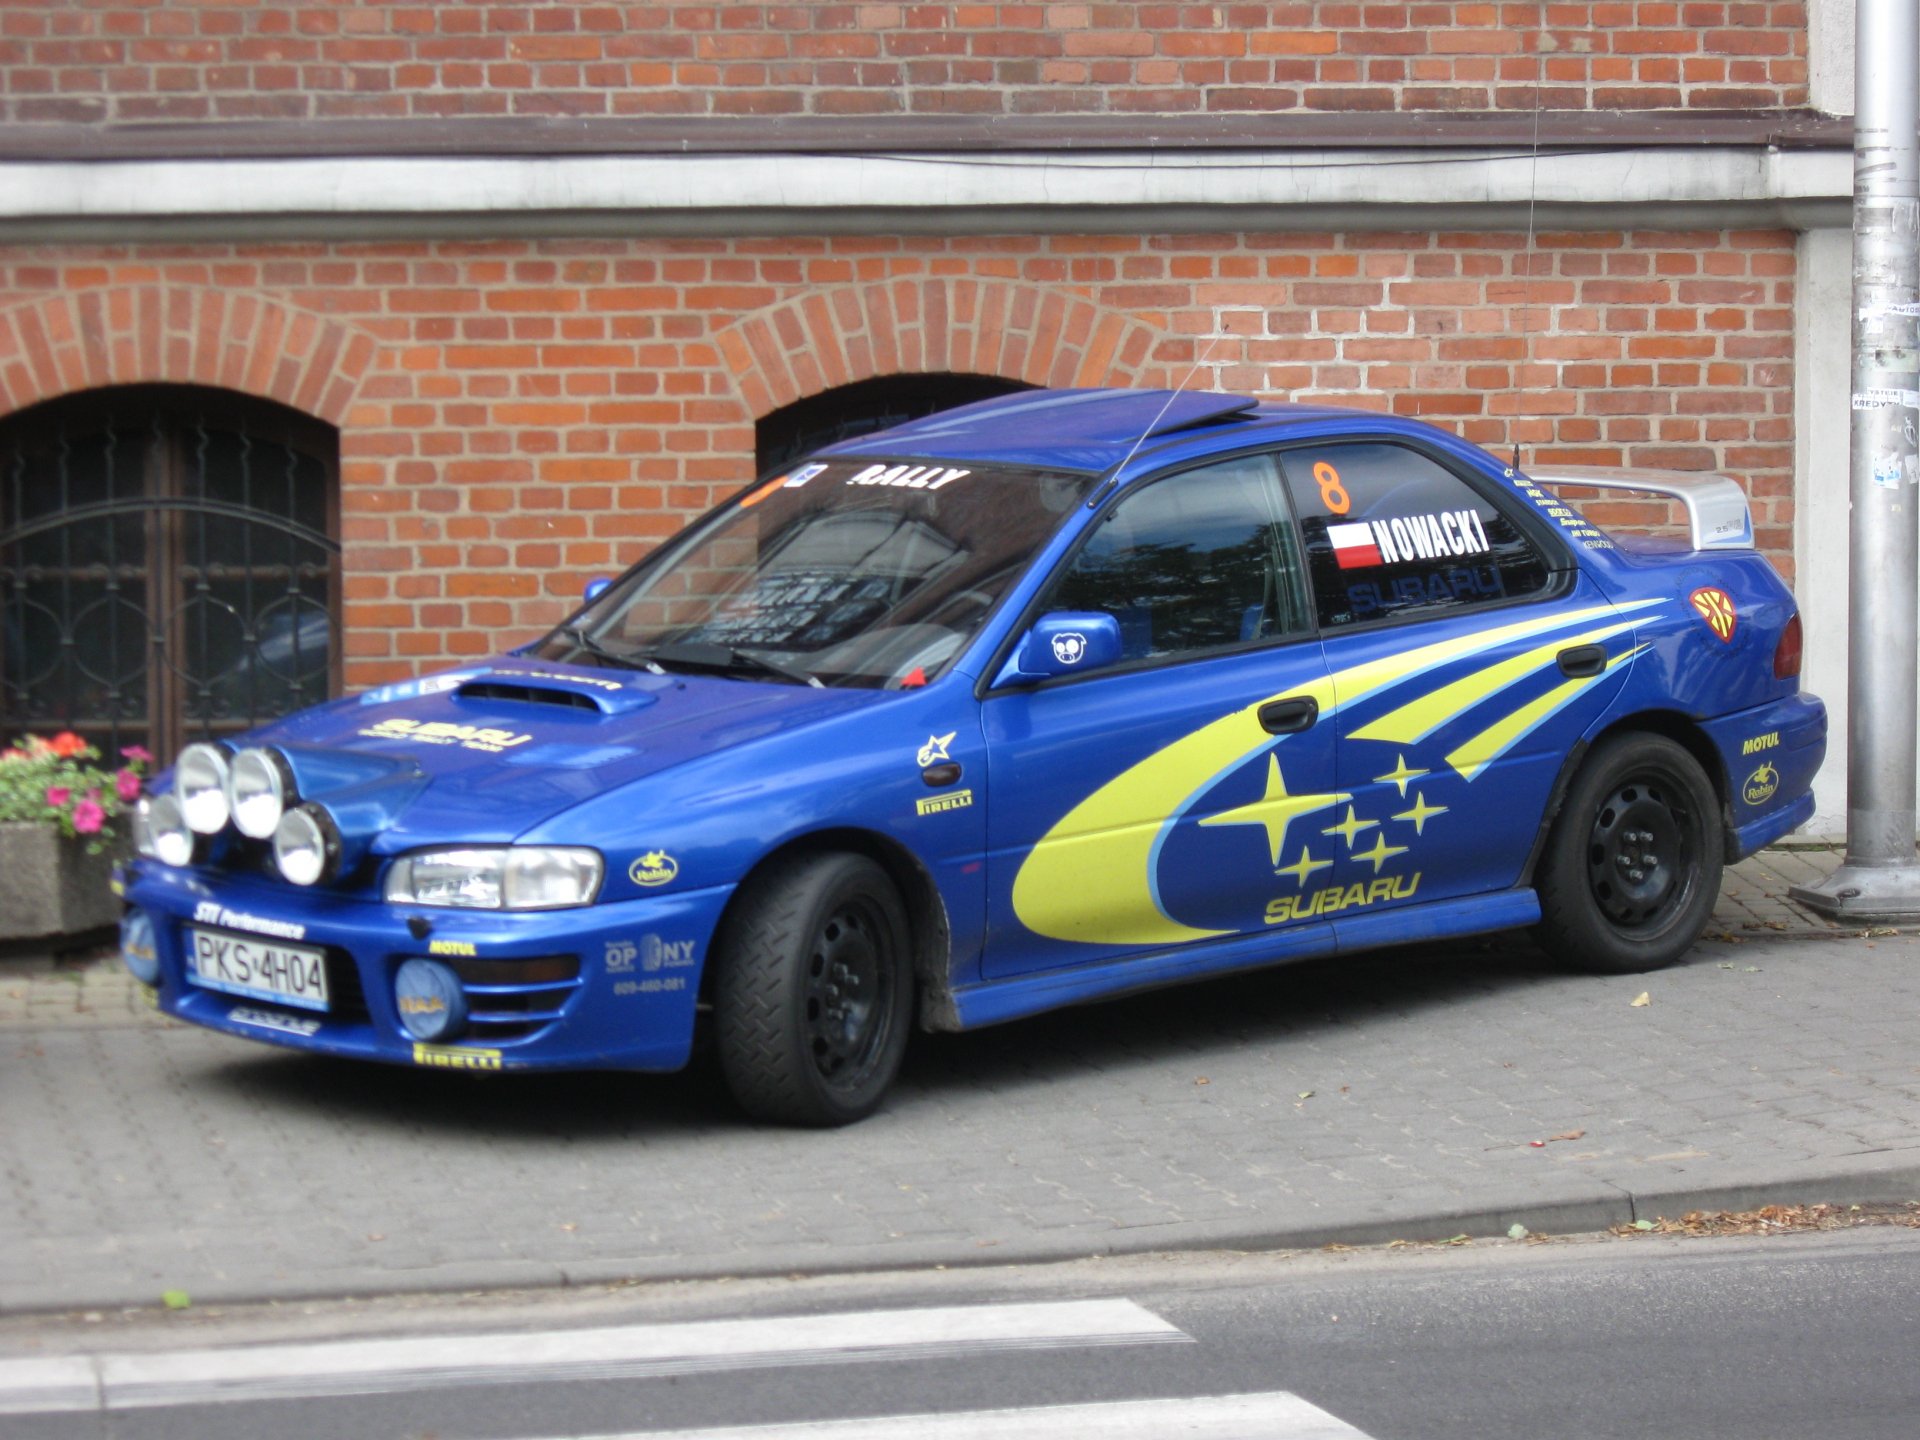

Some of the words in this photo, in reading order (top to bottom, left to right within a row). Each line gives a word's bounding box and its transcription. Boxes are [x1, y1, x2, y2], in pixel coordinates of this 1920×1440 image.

[846, 464, 971, 489] RALLY
[1313, 461, 1351, 515] 8
[1371, 509, 1490, 564] NOWACKI
[1347, 565, 1500, 613] SUBARU
[1743, 732, 1779, 755] MOTUL
[916, 788, 972, 816] PIRELLI
[1748, 783, 1775, 799] Robin
[1264, 872, 1421, 924] SUBARU
[429, 940, 477, 956] MOTUL
[198, 936, 251, 983] PKS
[260, 950, 323, 997] 4H04
[413, 1043, 502, 1070] PIRELLI
